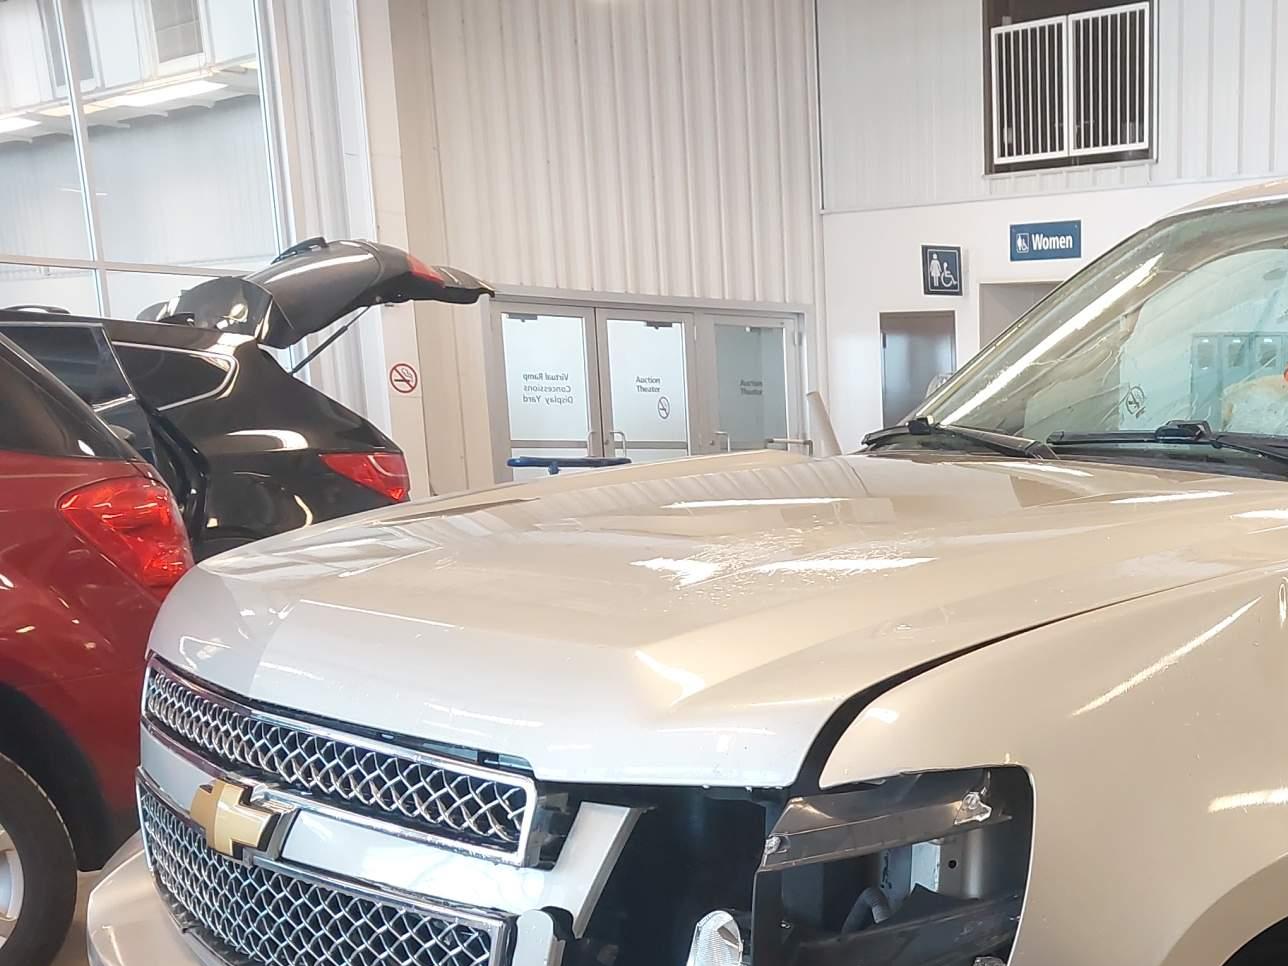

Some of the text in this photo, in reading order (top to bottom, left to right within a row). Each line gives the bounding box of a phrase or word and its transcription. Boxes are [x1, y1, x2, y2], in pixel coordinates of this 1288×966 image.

[1031, 233, 1073, 250] Women
[636, 376, 661, 384] Auction
[636, 385, 661, 393] Theater
